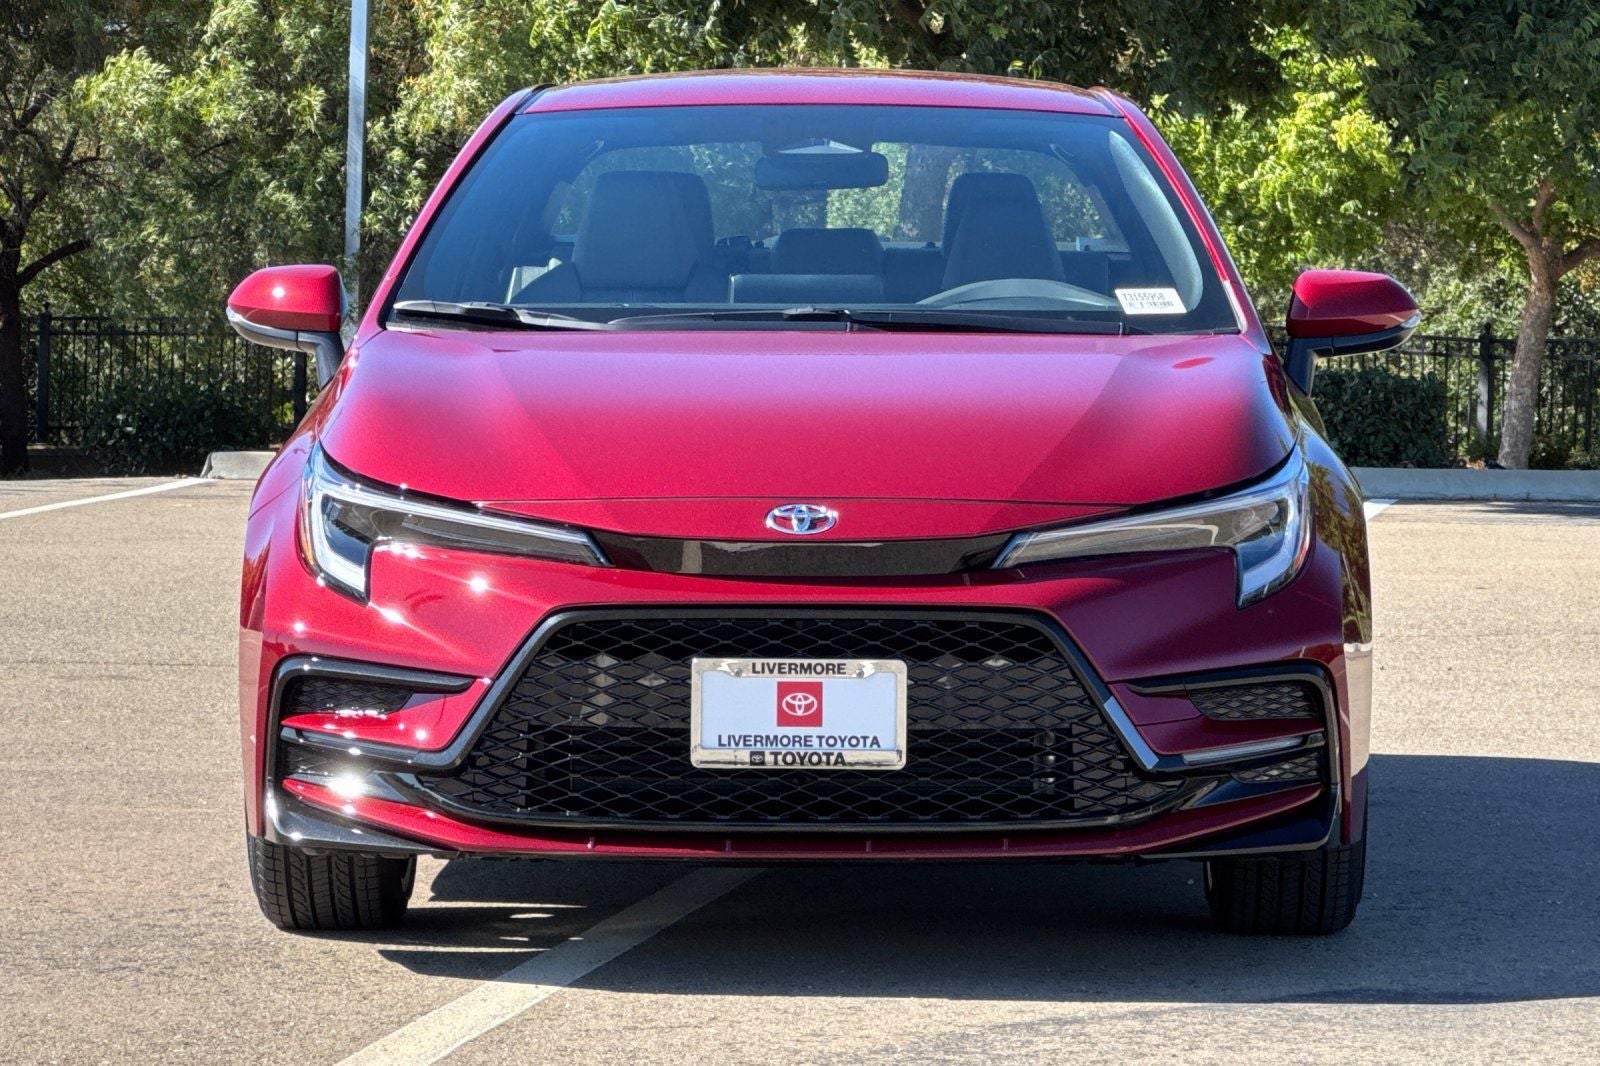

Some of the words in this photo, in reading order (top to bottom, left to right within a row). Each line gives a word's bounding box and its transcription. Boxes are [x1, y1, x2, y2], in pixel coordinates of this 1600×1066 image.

[751, 662, 847, 675] LIVERMORE
[717, 734, 813, 748] LIVERMORE
[816, 735, 881, 748] TOYOTA
[770, 751, 846, 766] TOYOTA
